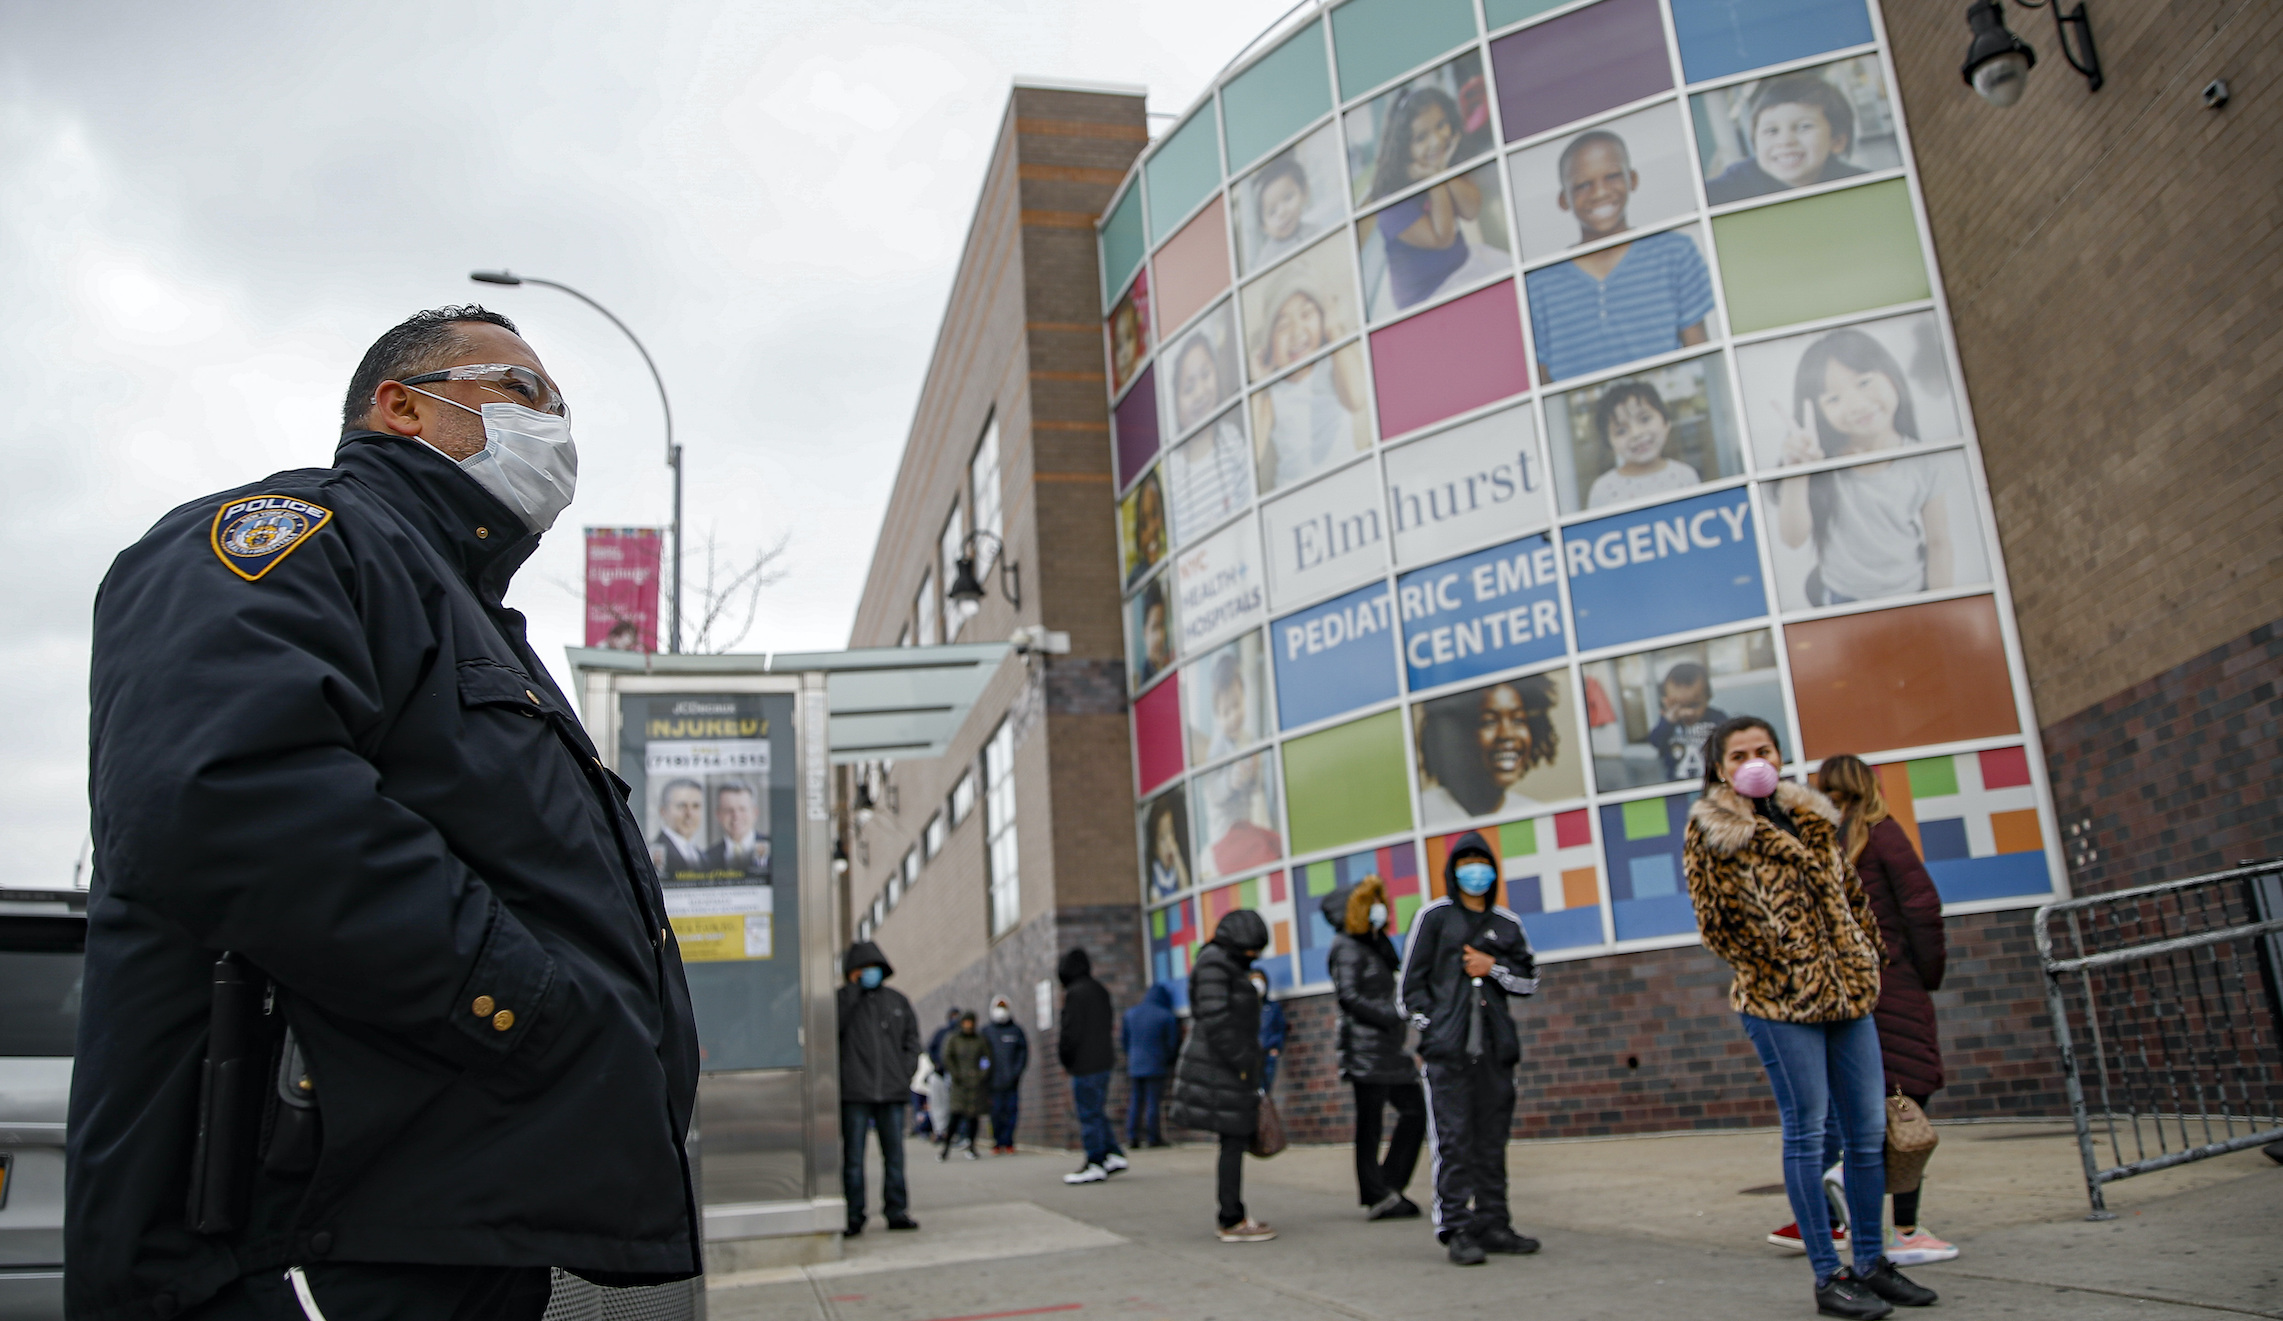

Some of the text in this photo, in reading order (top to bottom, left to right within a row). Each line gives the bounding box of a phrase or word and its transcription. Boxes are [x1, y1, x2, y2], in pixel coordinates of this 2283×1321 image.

[223, 498, 325, 520] POLICE
[1291, 450, 1541, 574] Elmhurst
[1179, 550, 1208, 580] NYC
[1284, 502, 1750, 662] PEDIATRIC EMERGENCY
[1185, 585, 1262, 637] HOSPITALS
[1406, 599, 1561, 670] CENTER
